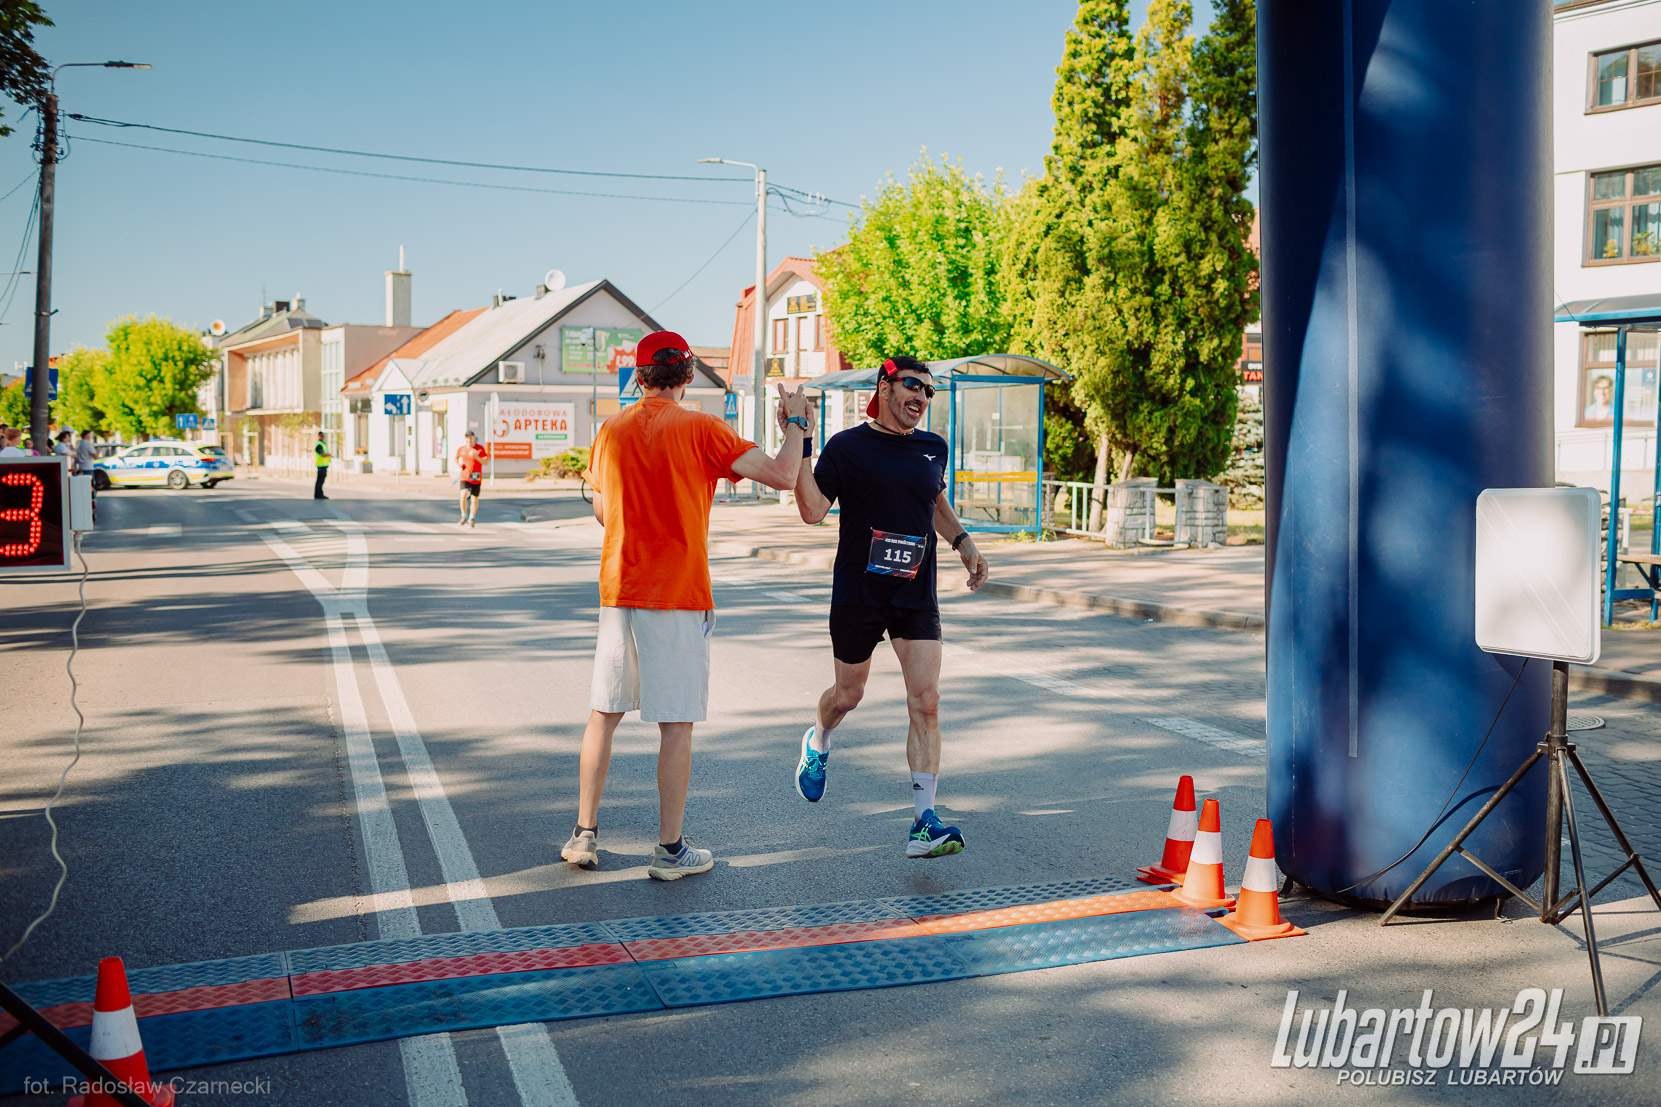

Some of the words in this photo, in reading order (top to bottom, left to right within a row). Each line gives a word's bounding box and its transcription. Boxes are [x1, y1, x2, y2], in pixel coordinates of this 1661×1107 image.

[499, 408, 568, 417] AŁODOBOWA
[513, 418, 568, 431] APTEKA
[884, 548, 912, 564] 115
